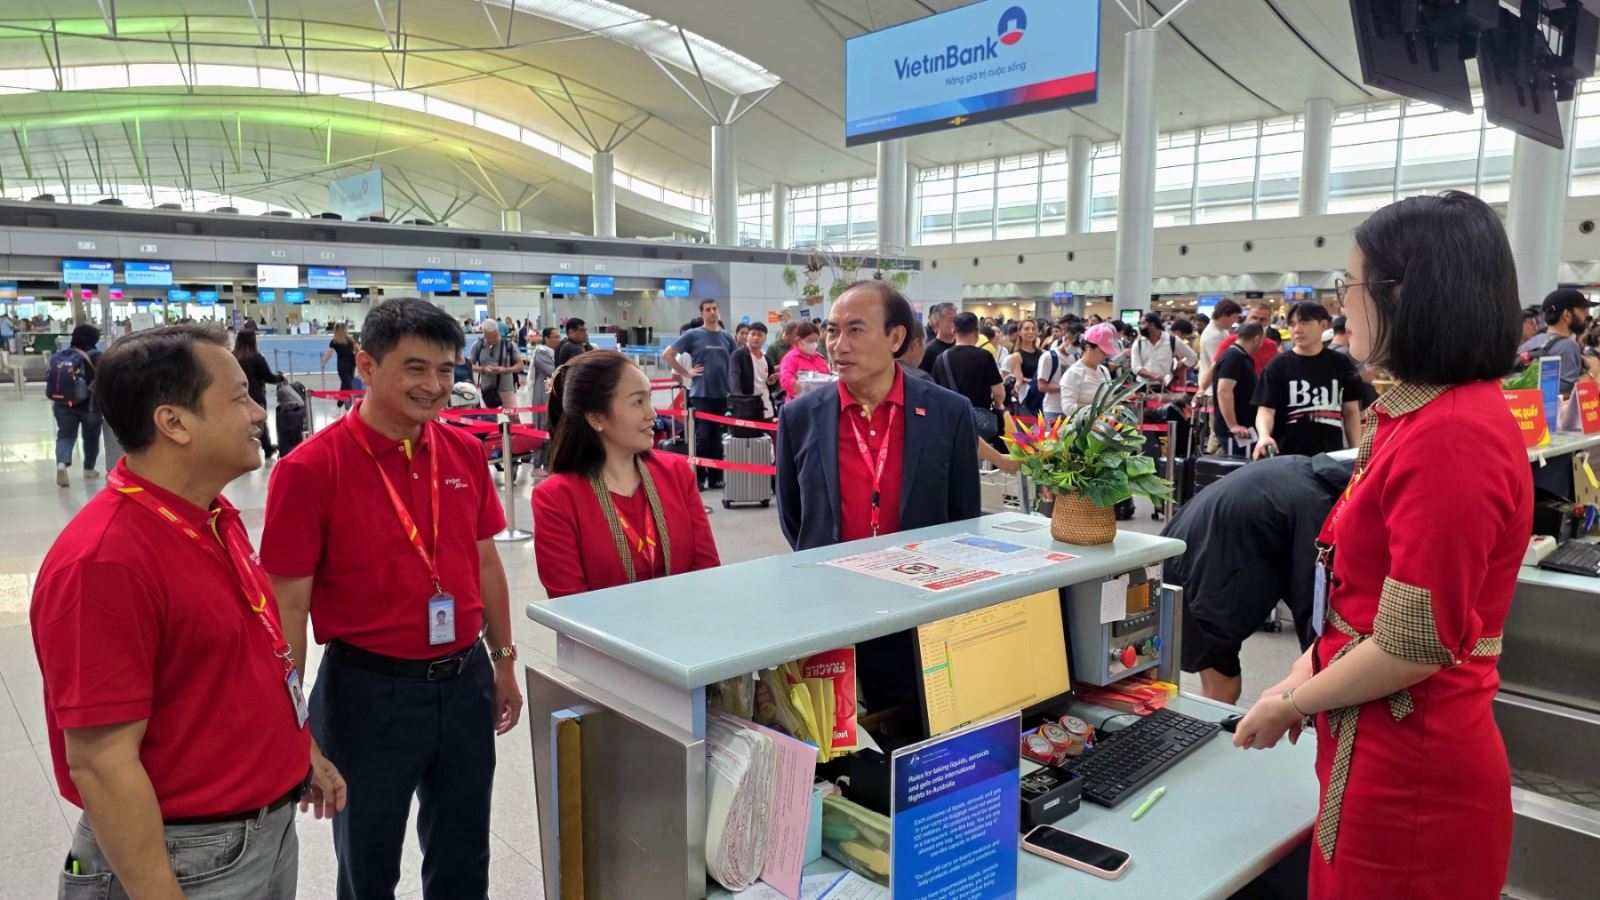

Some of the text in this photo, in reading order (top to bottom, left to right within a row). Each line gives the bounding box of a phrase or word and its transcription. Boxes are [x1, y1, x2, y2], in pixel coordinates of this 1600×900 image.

[894, 36, 998, 80] VietinBank
[1007, 62, 1026, 74] sống
[909, 774, 923, 782] Rules
[933, 765, 948, 774] taking
[950, 758, 967, 767] liquids,
[909, 763, 975, 792] and gels onto international
[908, 792, 924, 802] flights
[933, 781, 955, 793] Australia
